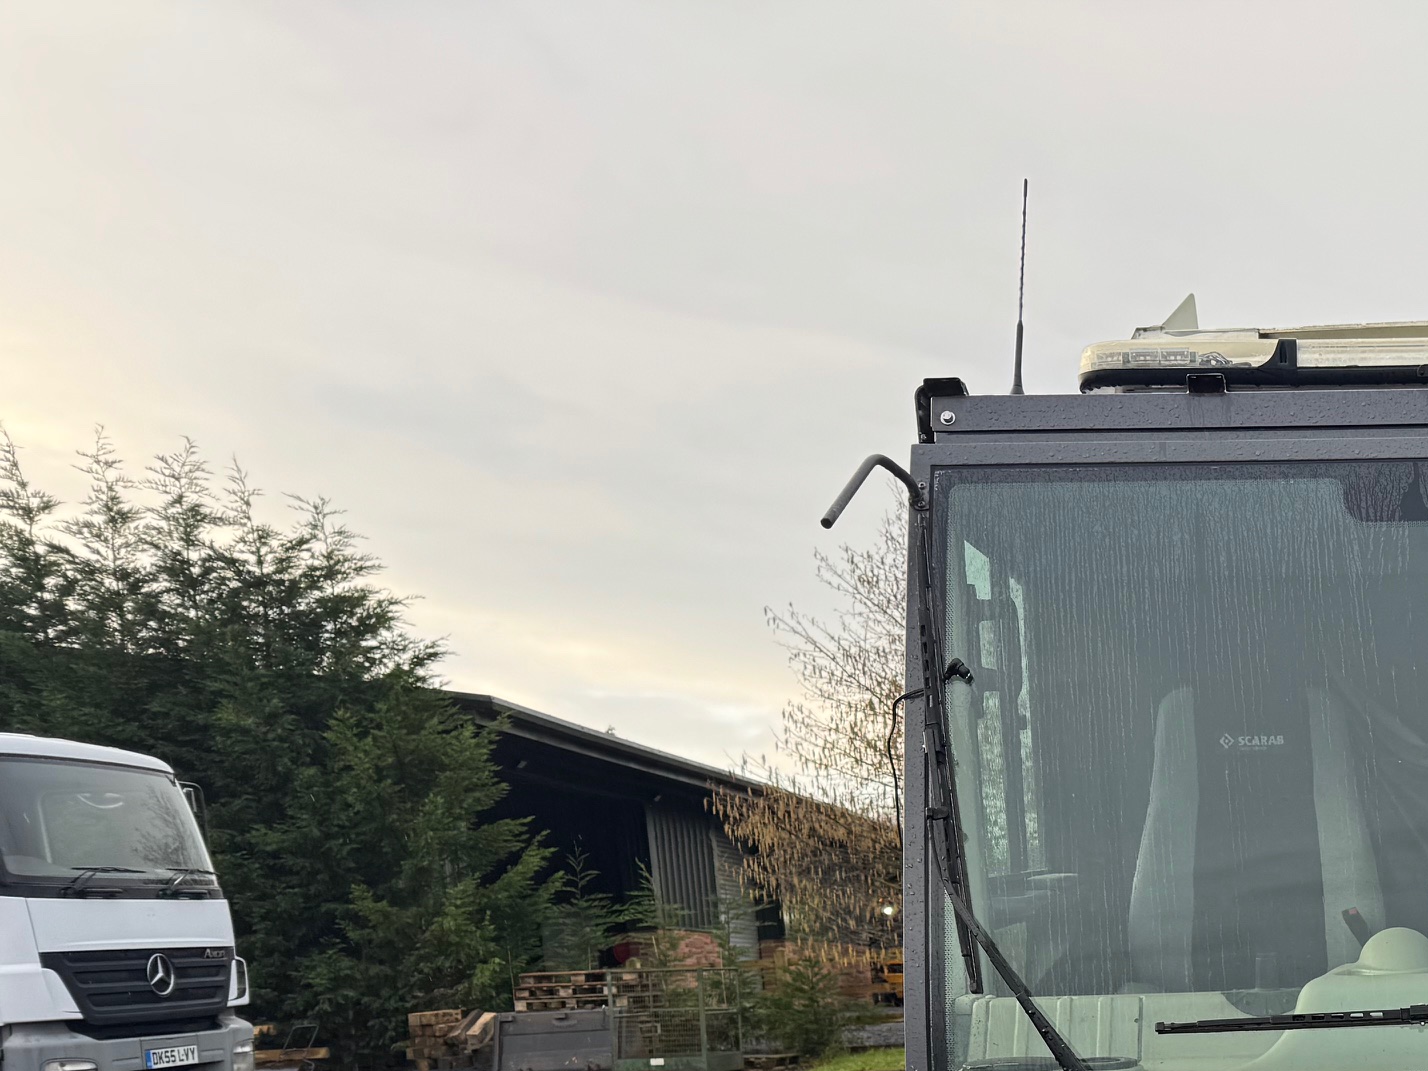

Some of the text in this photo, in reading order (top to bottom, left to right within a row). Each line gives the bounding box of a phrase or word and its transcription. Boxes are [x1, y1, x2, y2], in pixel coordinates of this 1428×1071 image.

[1238, 735, 1284, 746] SCARAB
[151, 1047, 196, 1066] DK55 LVY
